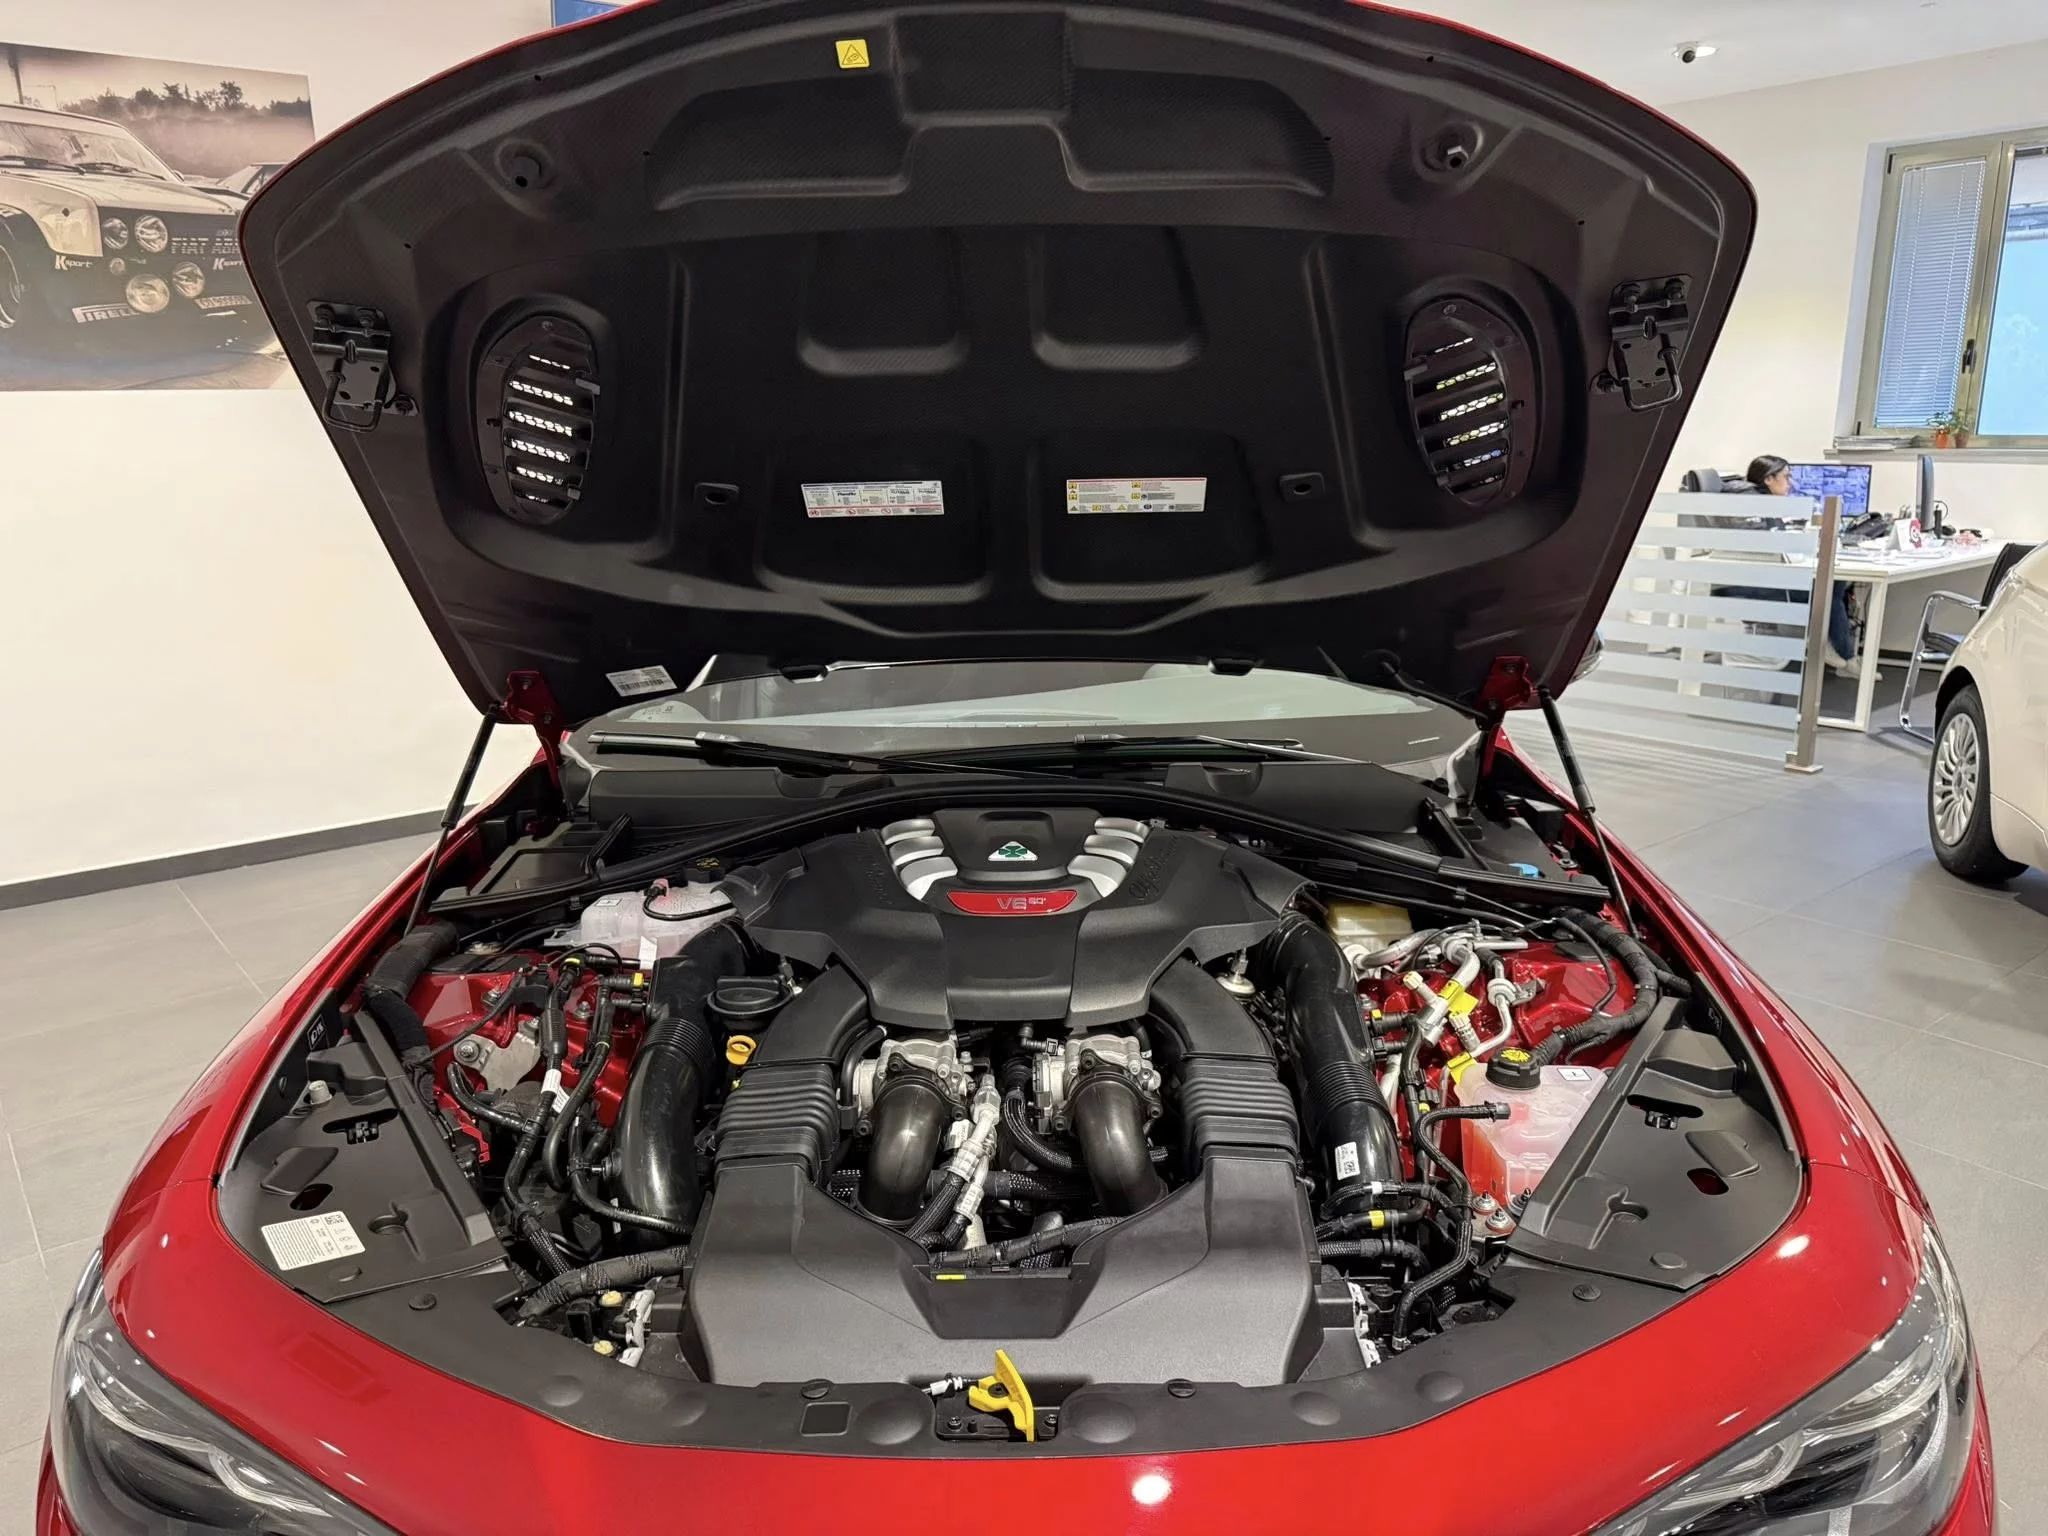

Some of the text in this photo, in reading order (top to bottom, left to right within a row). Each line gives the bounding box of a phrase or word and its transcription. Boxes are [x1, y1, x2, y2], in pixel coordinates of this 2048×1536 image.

[171, 237, 241, 254] FIAT ABA
[54, 254, 93, 271] Ksport
[72, 302, 141, 323] PIRELL
[996, 896, 1027, 910] V6
